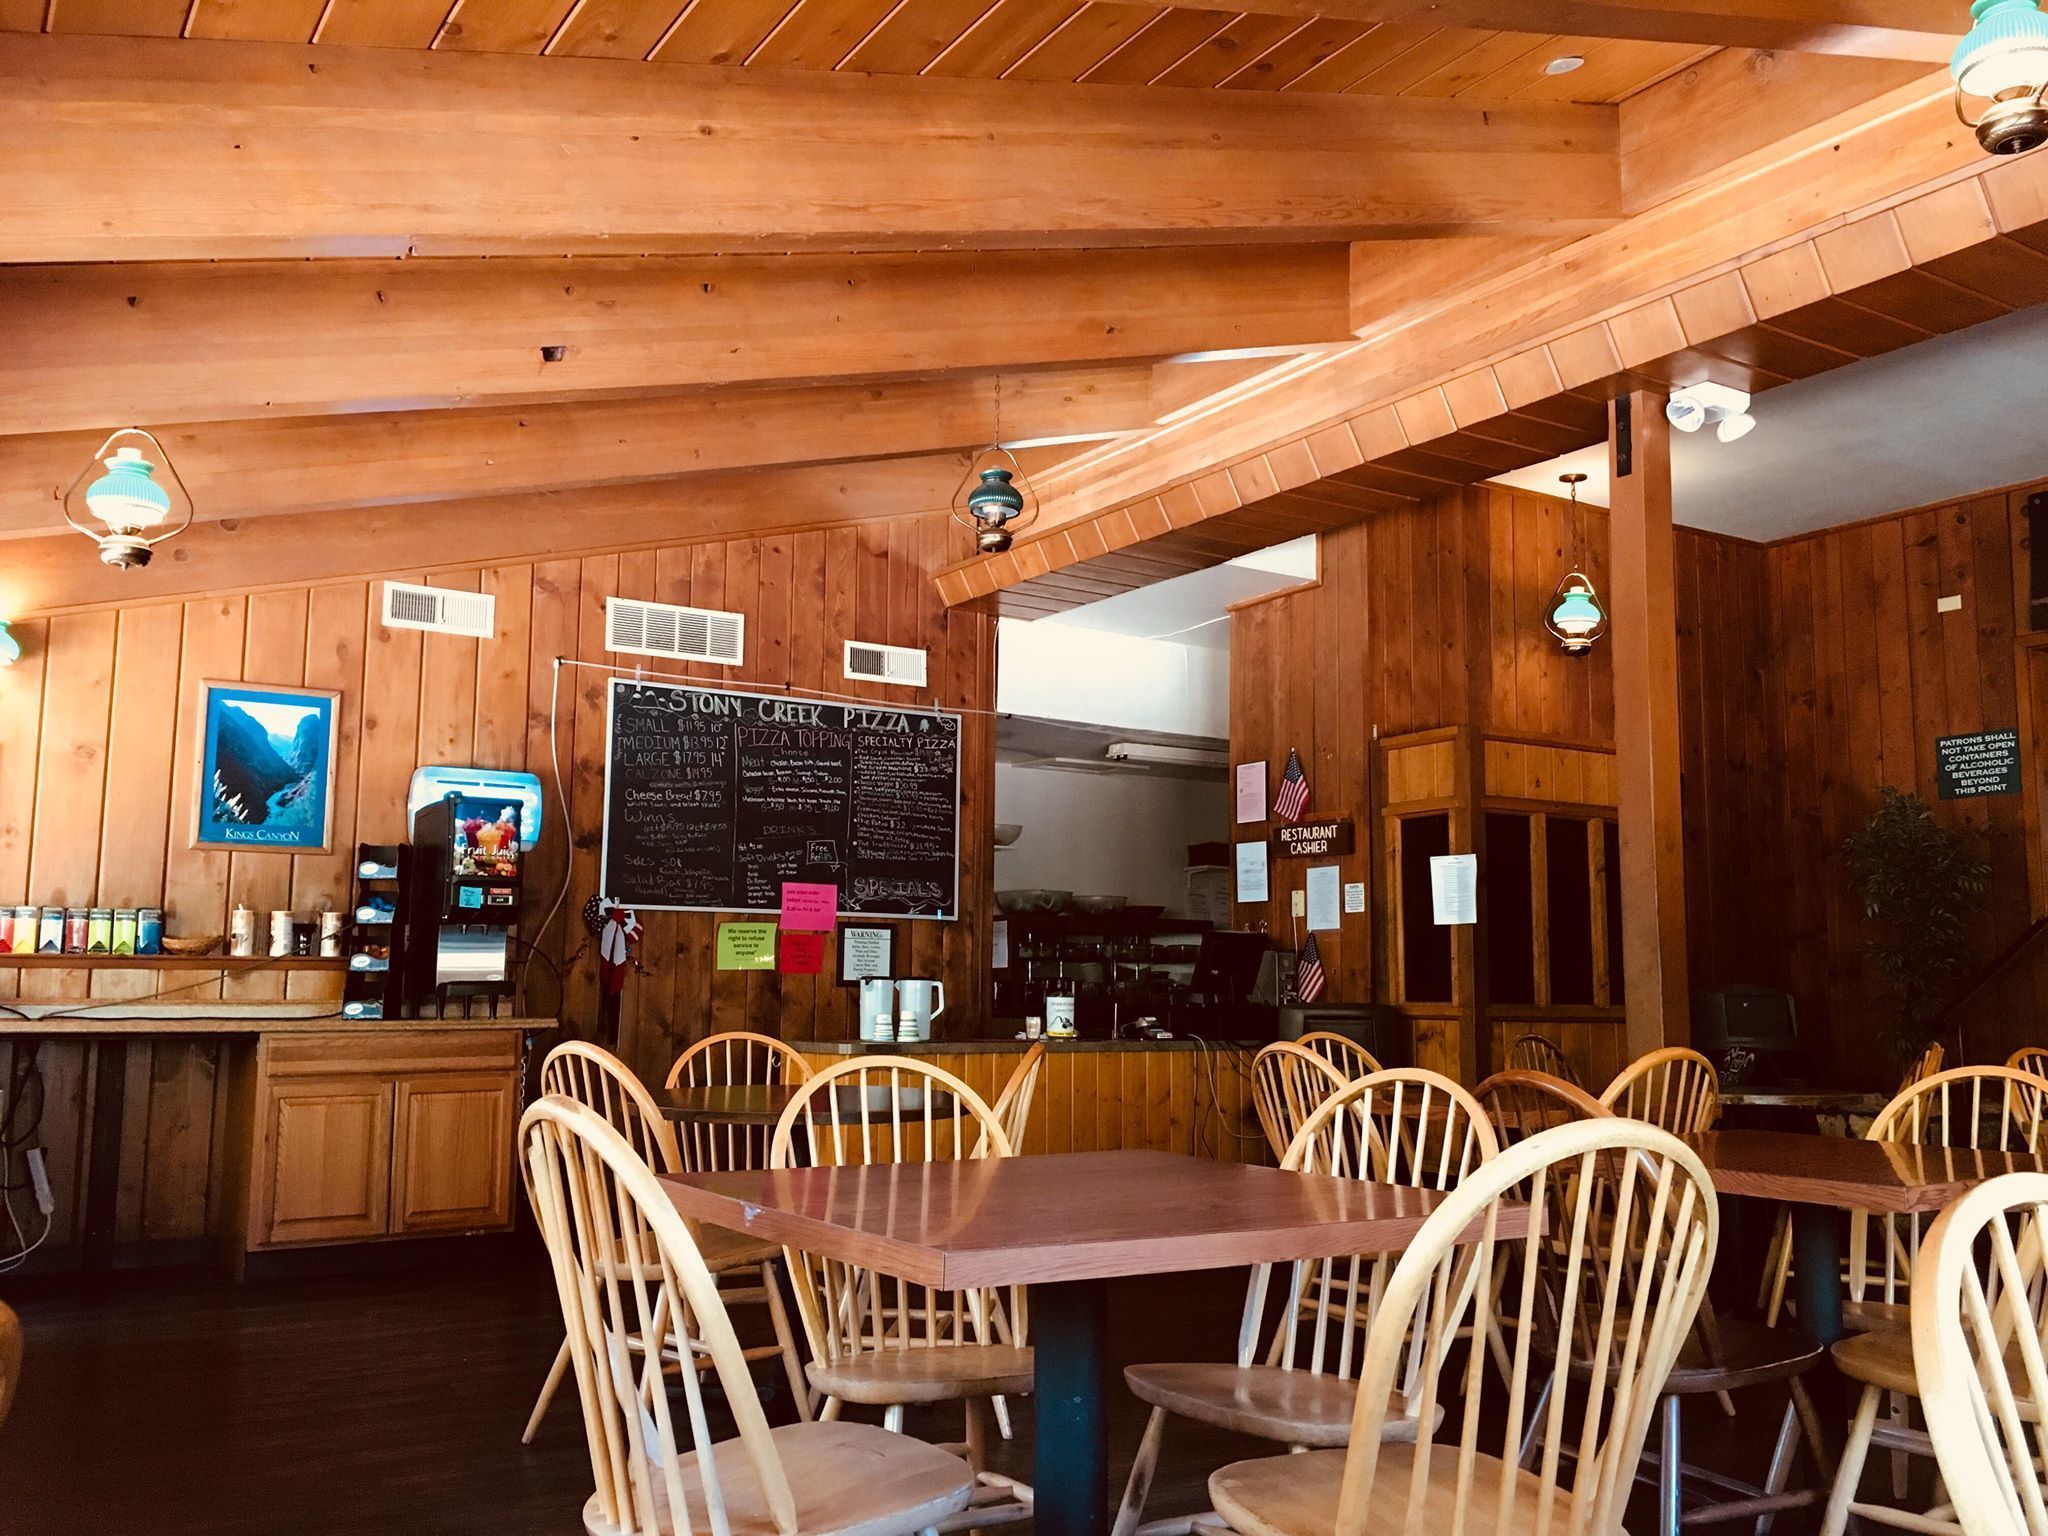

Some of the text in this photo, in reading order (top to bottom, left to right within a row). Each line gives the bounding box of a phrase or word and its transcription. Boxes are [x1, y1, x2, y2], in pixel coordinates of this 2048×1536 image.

[670, 690, 910, 733] STONY CREEK PIZZA
[624, 718, 670, 733] SMALL
[623, 736, 680, 750] MEDIUM
[738, 727, 790, 747] PIZZA
[858, 736, 955, 749] SPECIALTY PIZZA
[1940, 732, 2016, 747] PATRONS SHALL
[1941, 741, 2015, 755] NOT TAKE OPEN
[624, 751, 671, 766] LARGE
[673, 750, 706, 765] $17.95
[742, 755, 764, 768] Meat
[1948, 749, 2009, 763] CONTAINERS
[1960, 758, 2014, 770] ALCOHOLIC
[625, 768, 682, 780] CALZONE
[1952, 767, 2008, 779] BEVERAGES
[1961, 776, 2000, 786] BEYOND
[625, 788, 722, 802] Cheese Bread $7.95
[1954, 783, 2007, 795] THIS POINT
[624, 809, 675, 825] Wings
[225, 828, 300, 841] KINGS CANYON
[763, 825, 816, 835] DRINKS
[1281, 825, 1338, 841] RESTAURANT
[810, 843, 828, 852] Free
[1290, 840, 1328, 855] CASHIER
